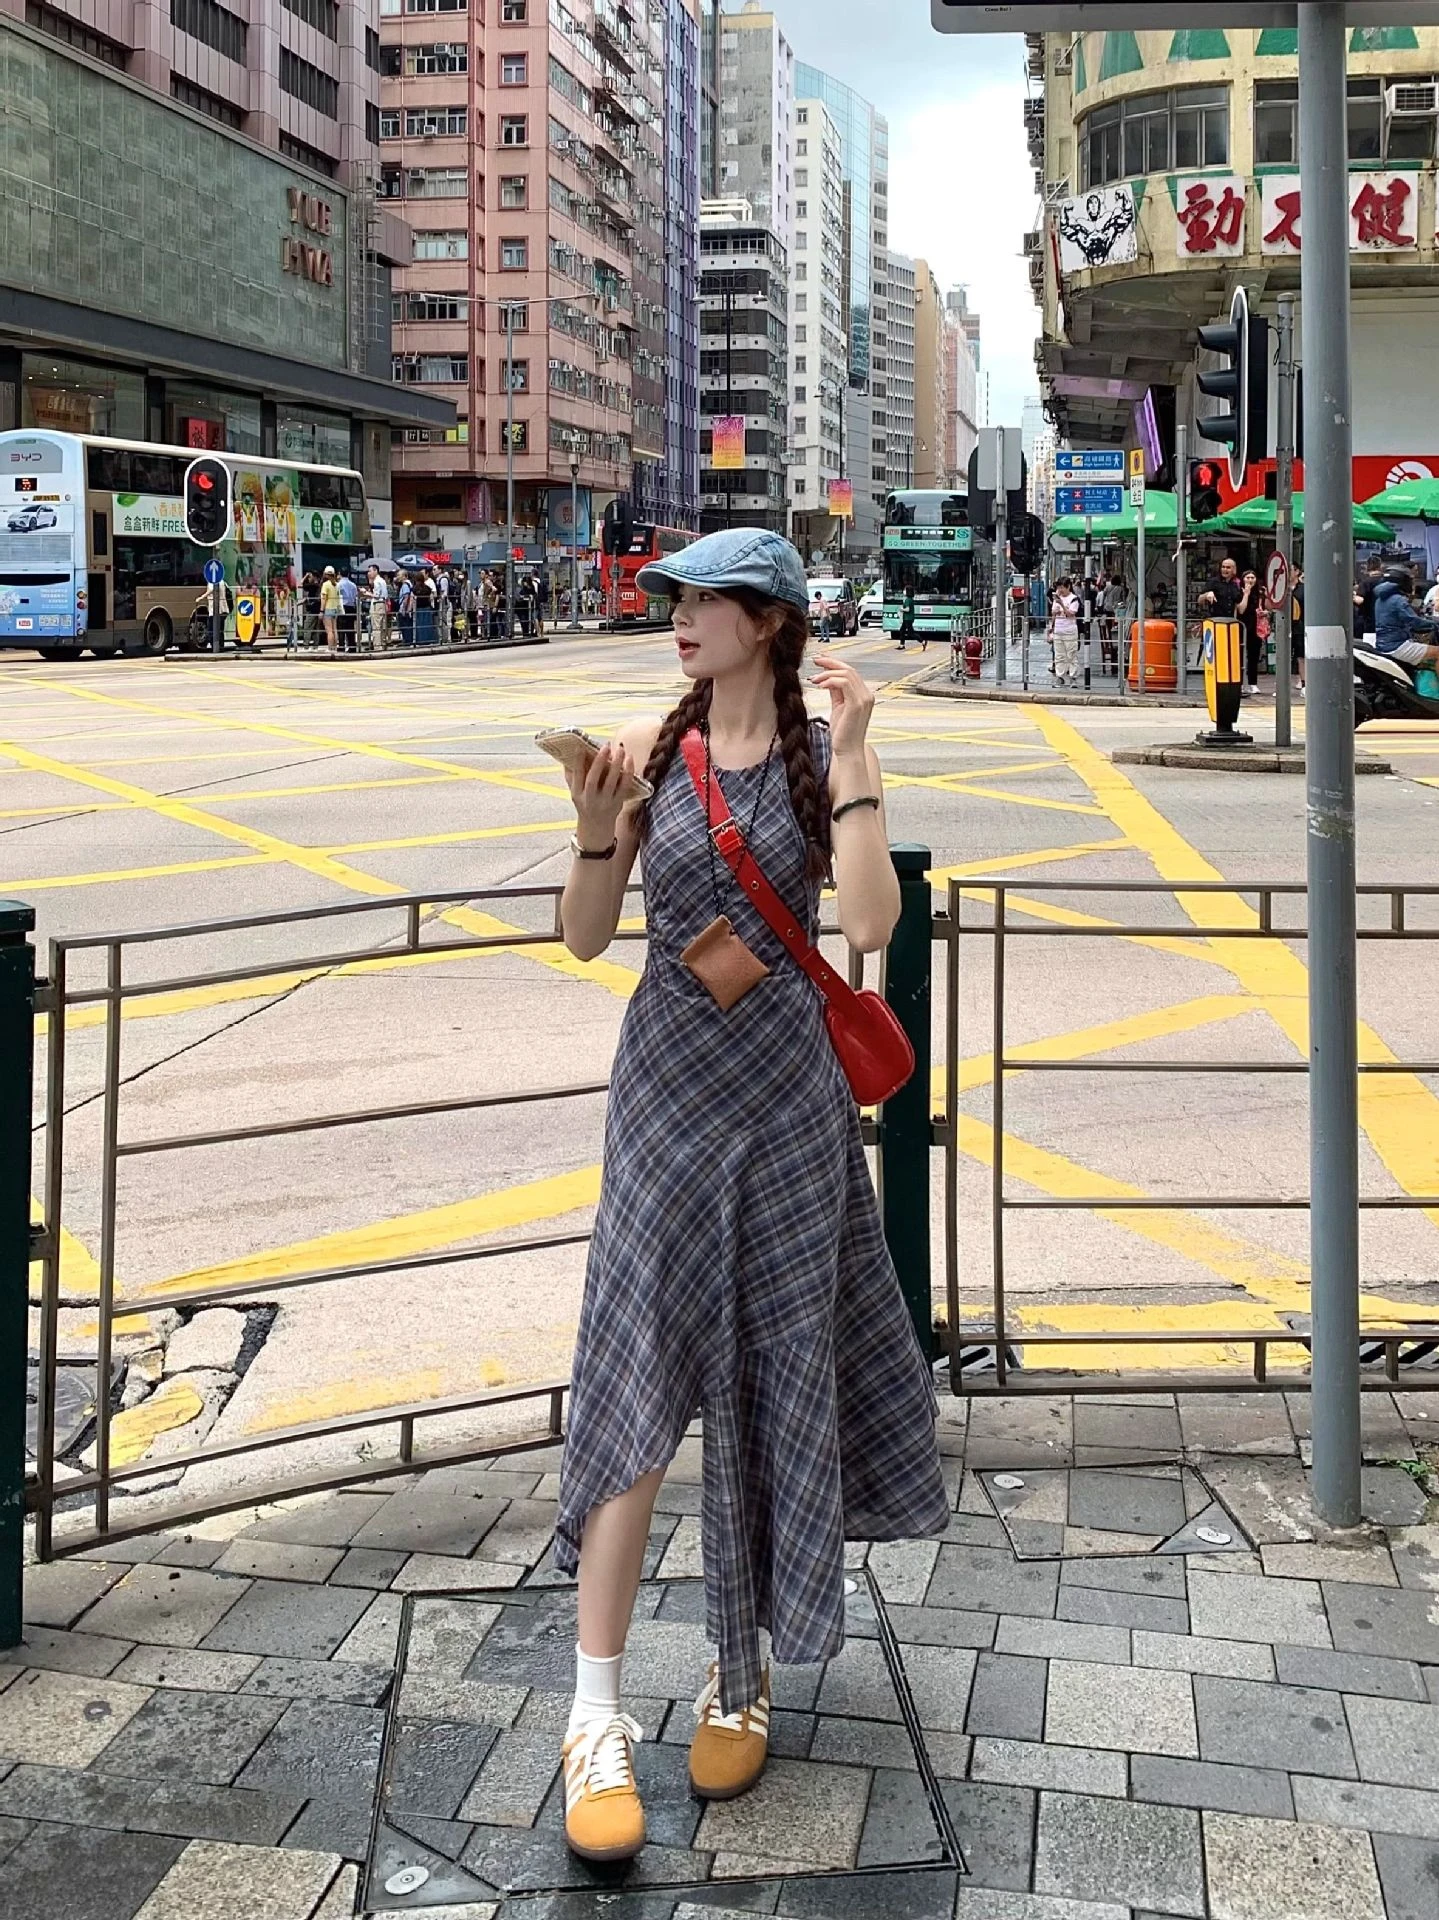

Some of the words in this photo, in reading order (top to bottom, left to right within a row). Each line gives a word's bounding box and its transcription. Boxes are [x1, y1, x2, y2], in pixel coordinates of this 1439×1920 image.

[287, 187, 332, 236] YUE
[282, 237, 334, 287] HWA
[10, 452, 43, 462] BYD
